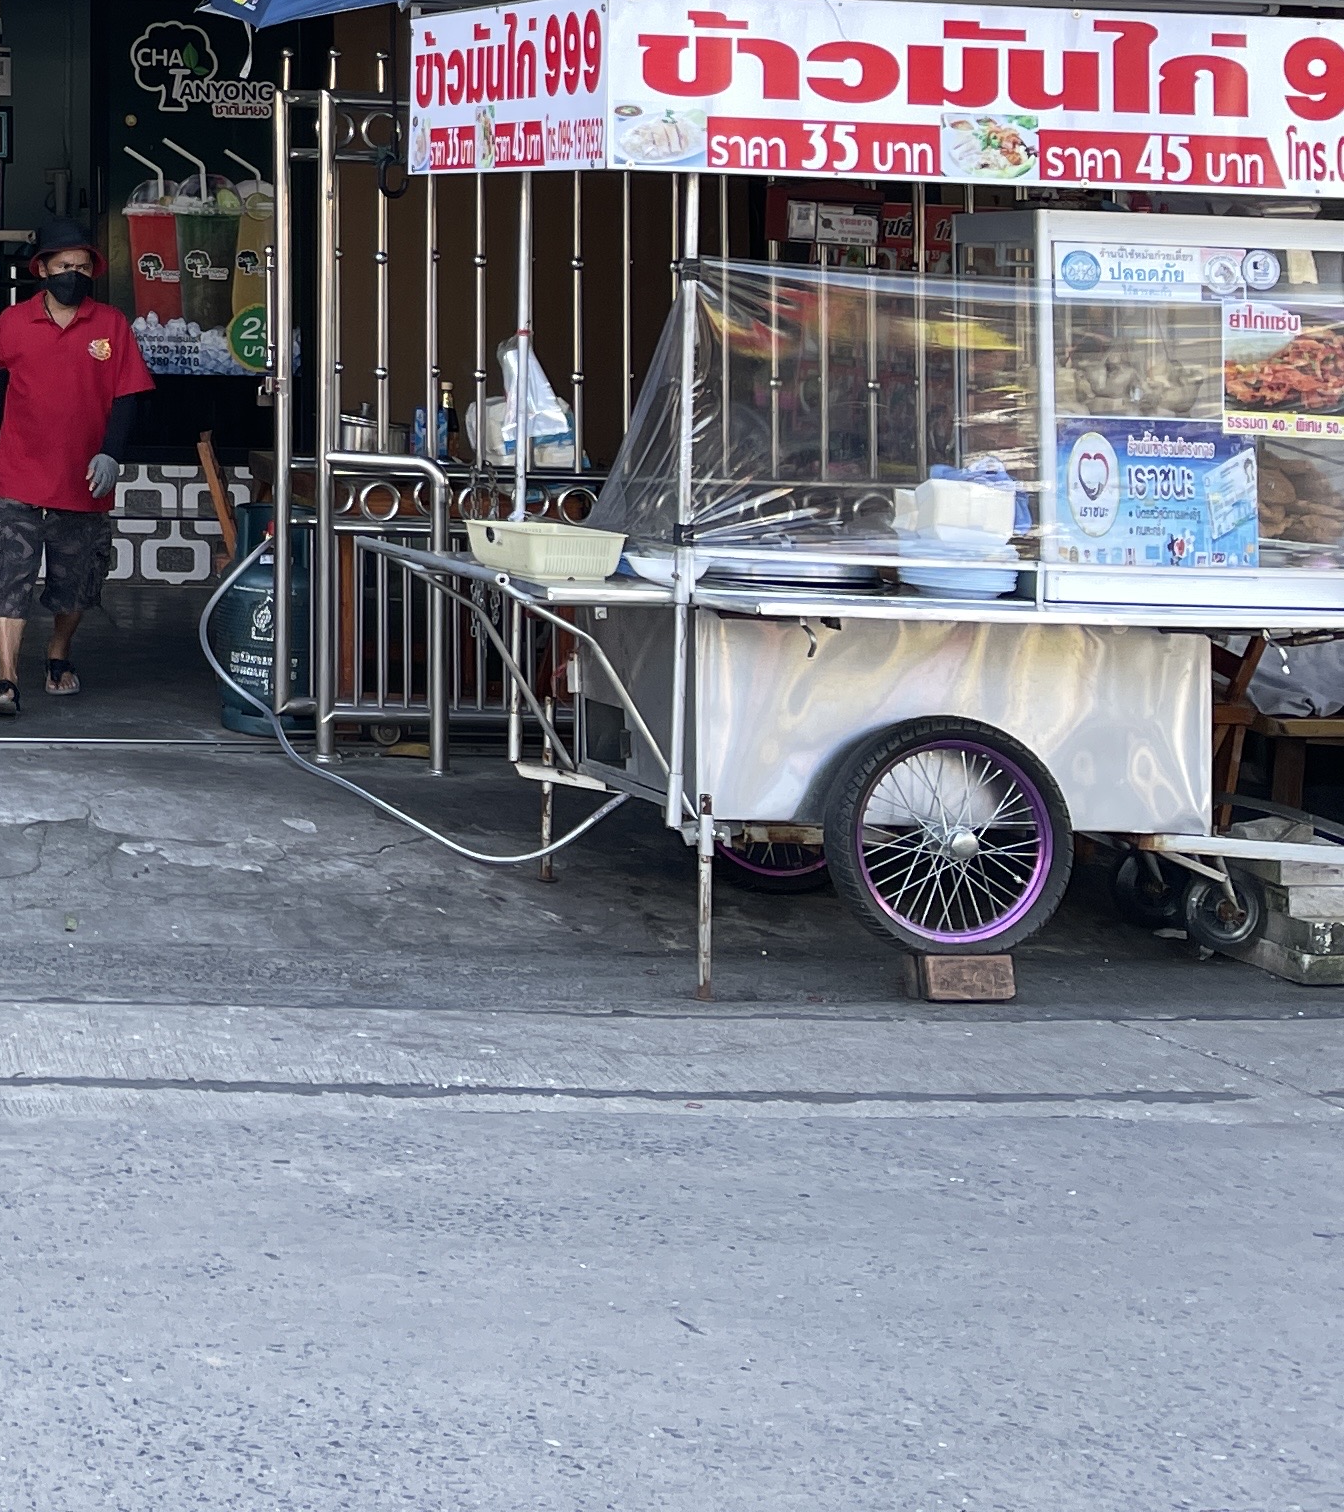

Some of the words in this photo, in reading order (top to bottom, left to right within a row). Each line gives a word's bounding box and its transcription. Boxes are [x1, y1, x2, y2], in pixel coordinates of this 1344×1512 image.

[137, 48, 185, 67] CHA
[415, 12, 537, 108] ข้าวมันไก่
[544, 9, 602, 97] 999
[638, 10, 1249, 118] ข้าวมันไก่
[169, 68, 274, 101] TANYONG
[447, 128, 460, 166] 35
[460, 139, 474, 165] บาท
[512, 122, 526, 162] 45
[527, 134, 540, 160] บาท
[711, 134, 787, 169] ราคา
[801, 122, 860, 172] 35
[872, 139, 934, 173] บาท
[1047, 150, 1123, 180] ราคา
[1136, 134, 1194, 183] 45
[1205, 151, 1265, 186] บาท
[1109, 261, 1185, 284] ปลอดภัย
[1128, 466, 1195, 500] เราชนะ
